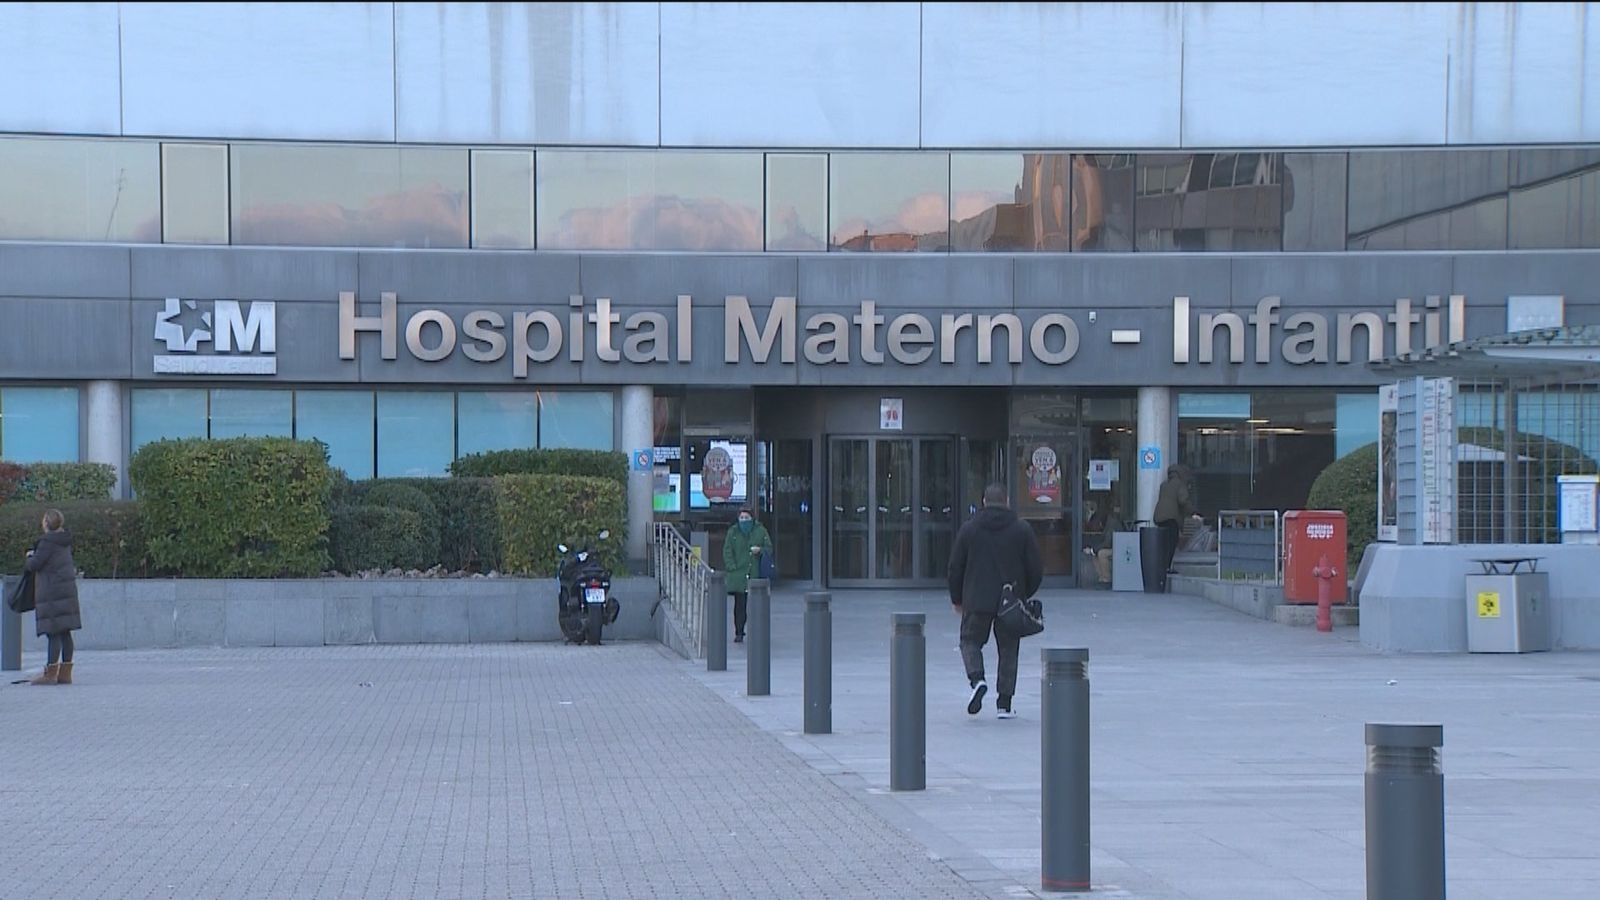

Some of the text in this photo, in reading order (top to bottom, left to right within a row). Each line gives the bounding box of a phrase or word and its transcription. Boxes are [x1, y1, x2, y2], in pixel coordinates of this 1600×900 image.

[214, 299, 276, 353] M
[338, 290, 1465, 378] Hospital Materno - Infantil
